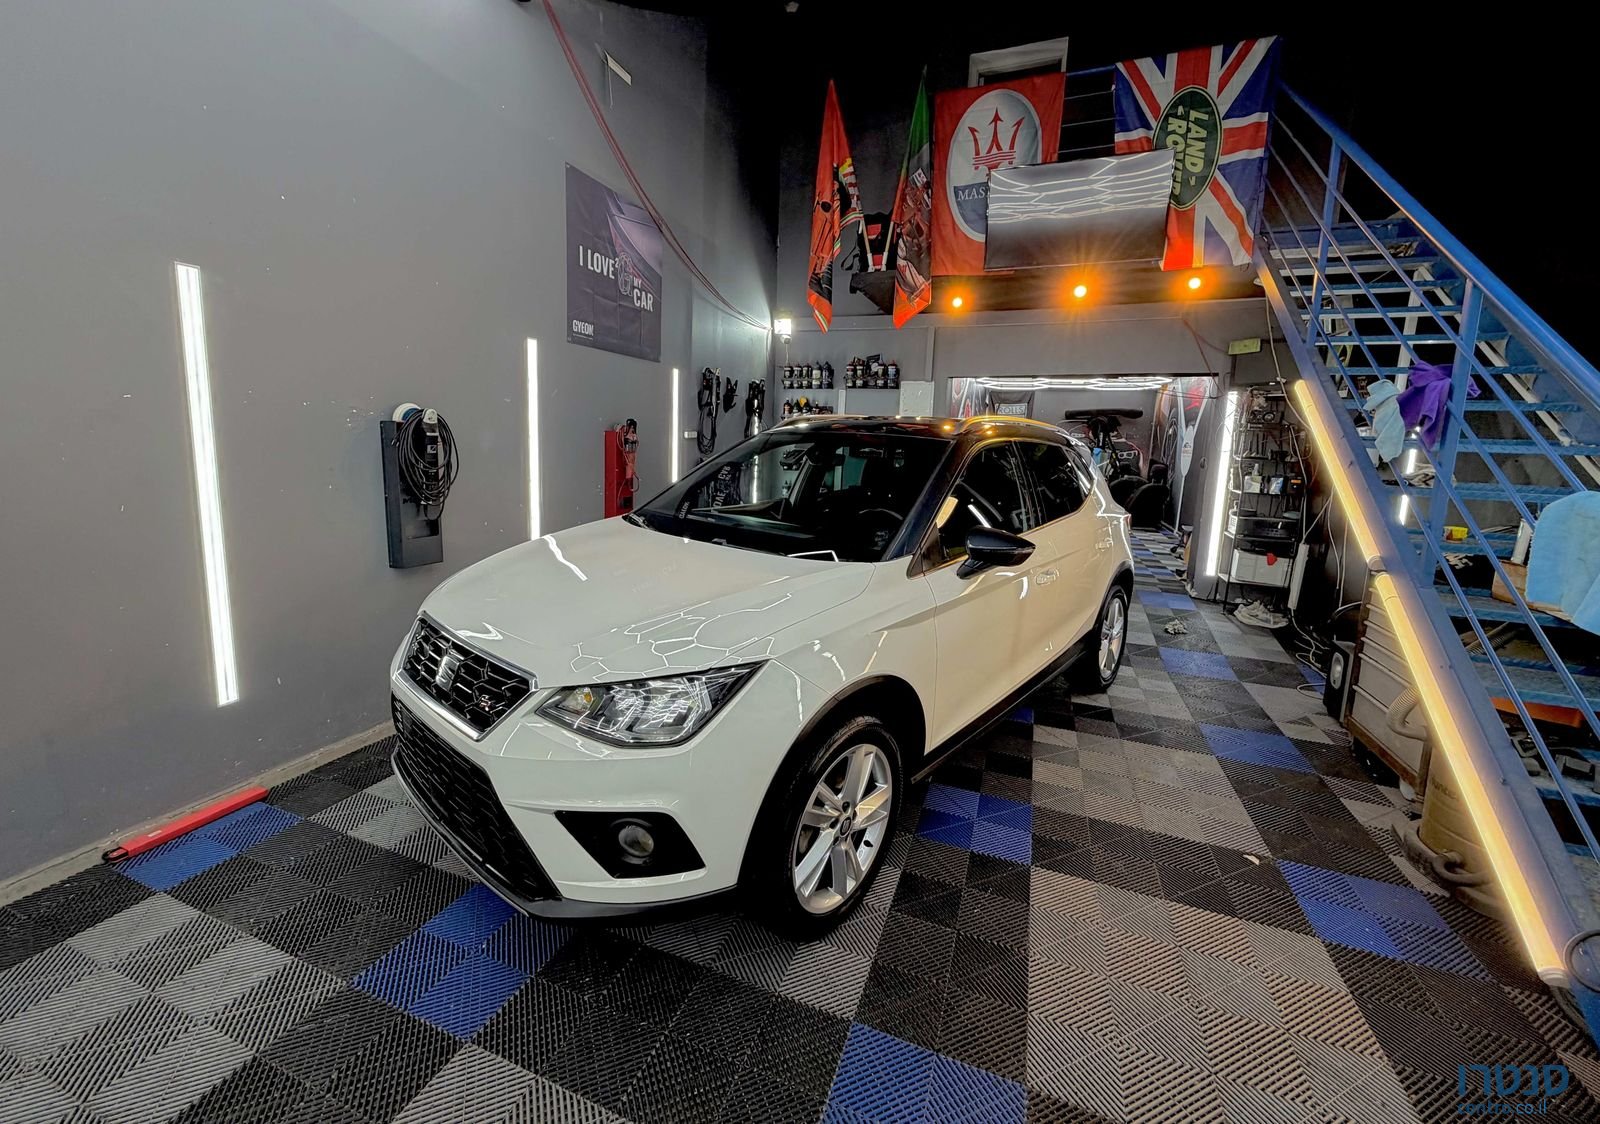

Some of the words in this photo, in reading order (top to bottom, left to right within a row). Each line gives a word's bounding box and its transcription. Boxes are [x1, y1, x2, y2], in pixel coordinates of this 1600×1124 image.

[1184, 109, 1209, 174] LAND
[957, 186, 988, 201] MAS
[579, 245, 584, 266] I
[634, 277, 642, 288] MY
[634, 289, 653, 311] CAR
[573, 320, 593, 335] GYEON
